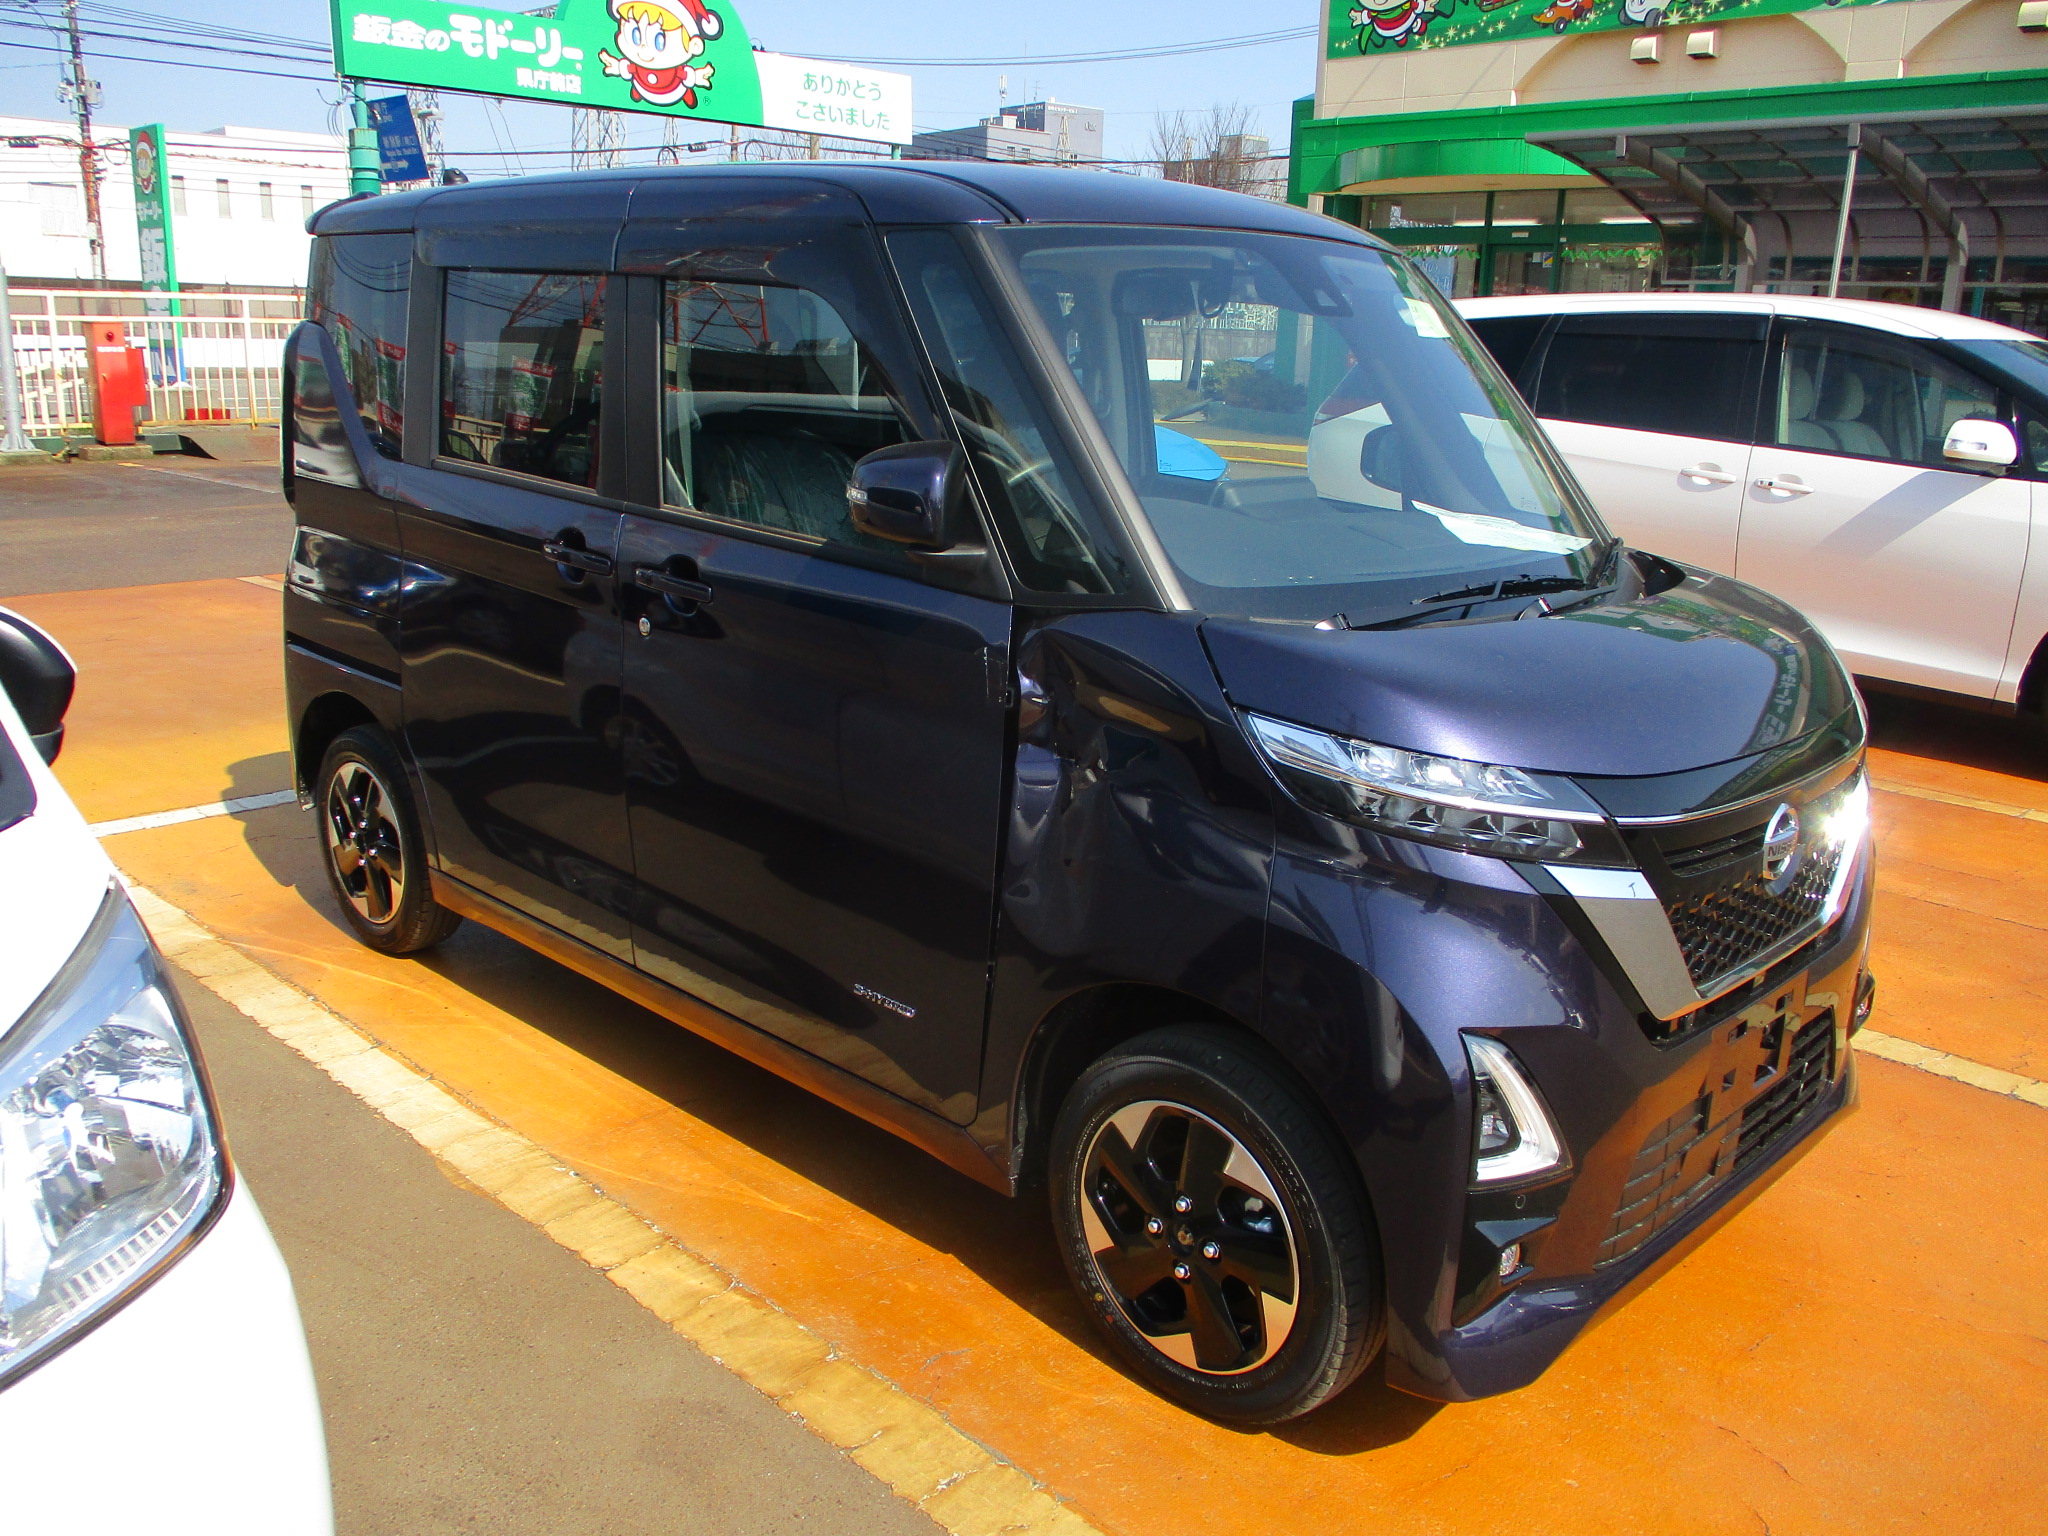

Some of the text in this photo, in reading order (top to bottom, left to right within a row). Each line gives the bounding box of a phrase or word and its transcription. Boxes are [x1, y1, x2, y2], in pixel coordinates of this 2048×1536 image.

[516, 67, 582, 95] 県庁前店
[1767, 839, 1796, 857] NISS
